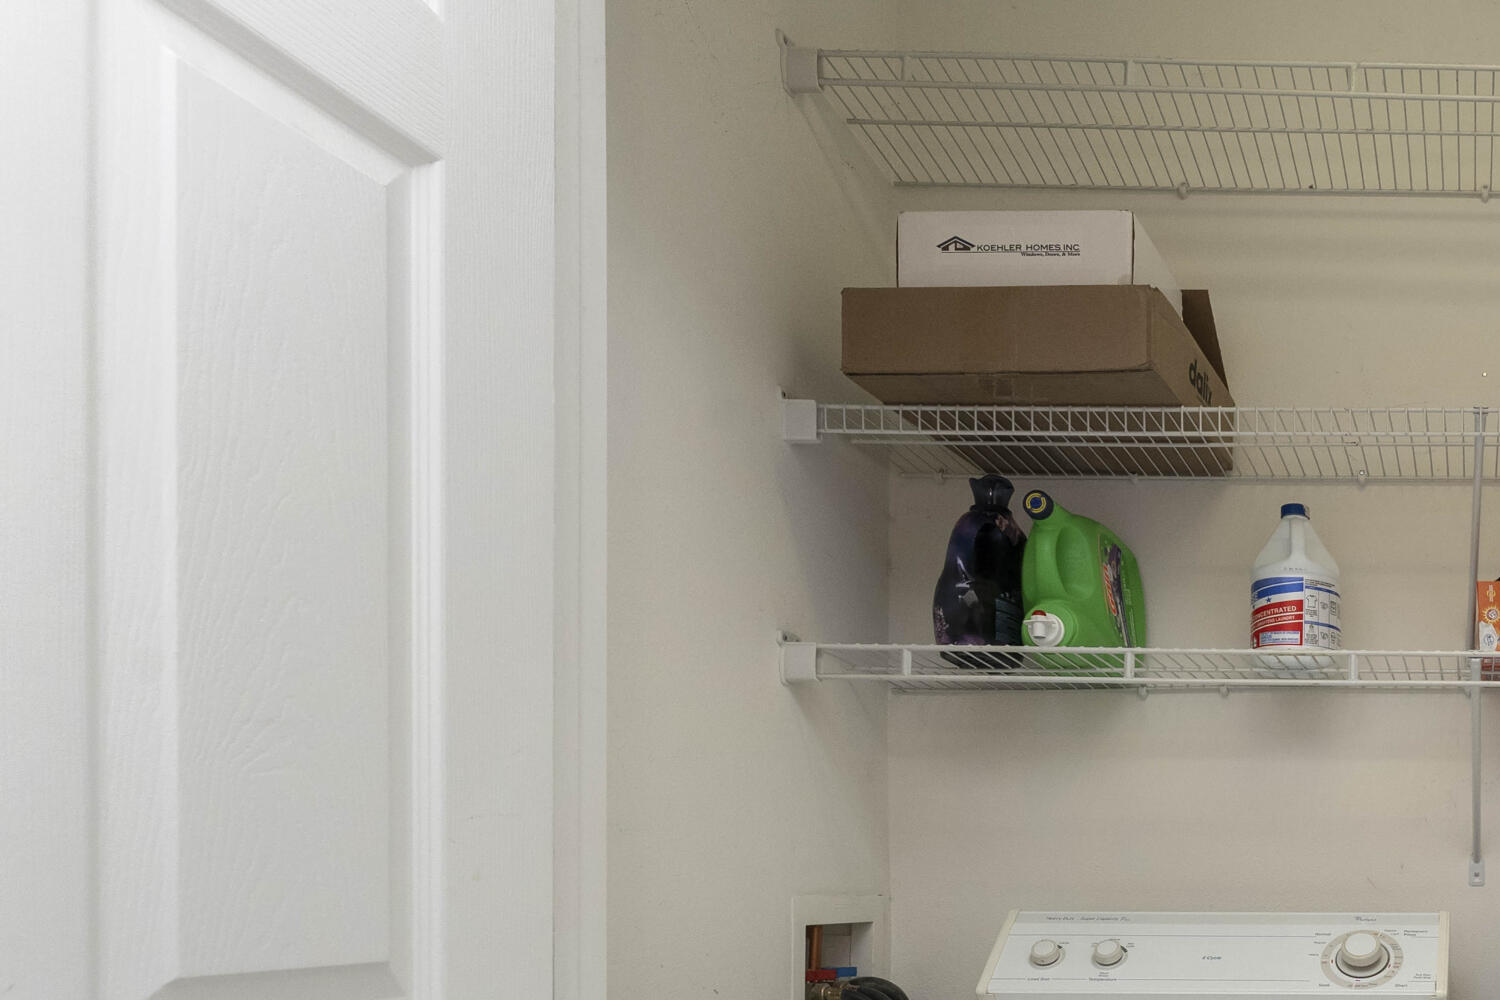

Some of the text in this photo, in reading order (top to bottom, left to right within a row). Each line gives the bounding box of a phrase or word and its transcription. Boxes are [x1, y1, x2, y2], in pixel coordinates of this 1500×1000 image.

[976, 244, 1022, 252] KOEHLER
[1063, 243, 1081, 251] INC
[1253, 606, 1297, 620] ONCENTRATED
